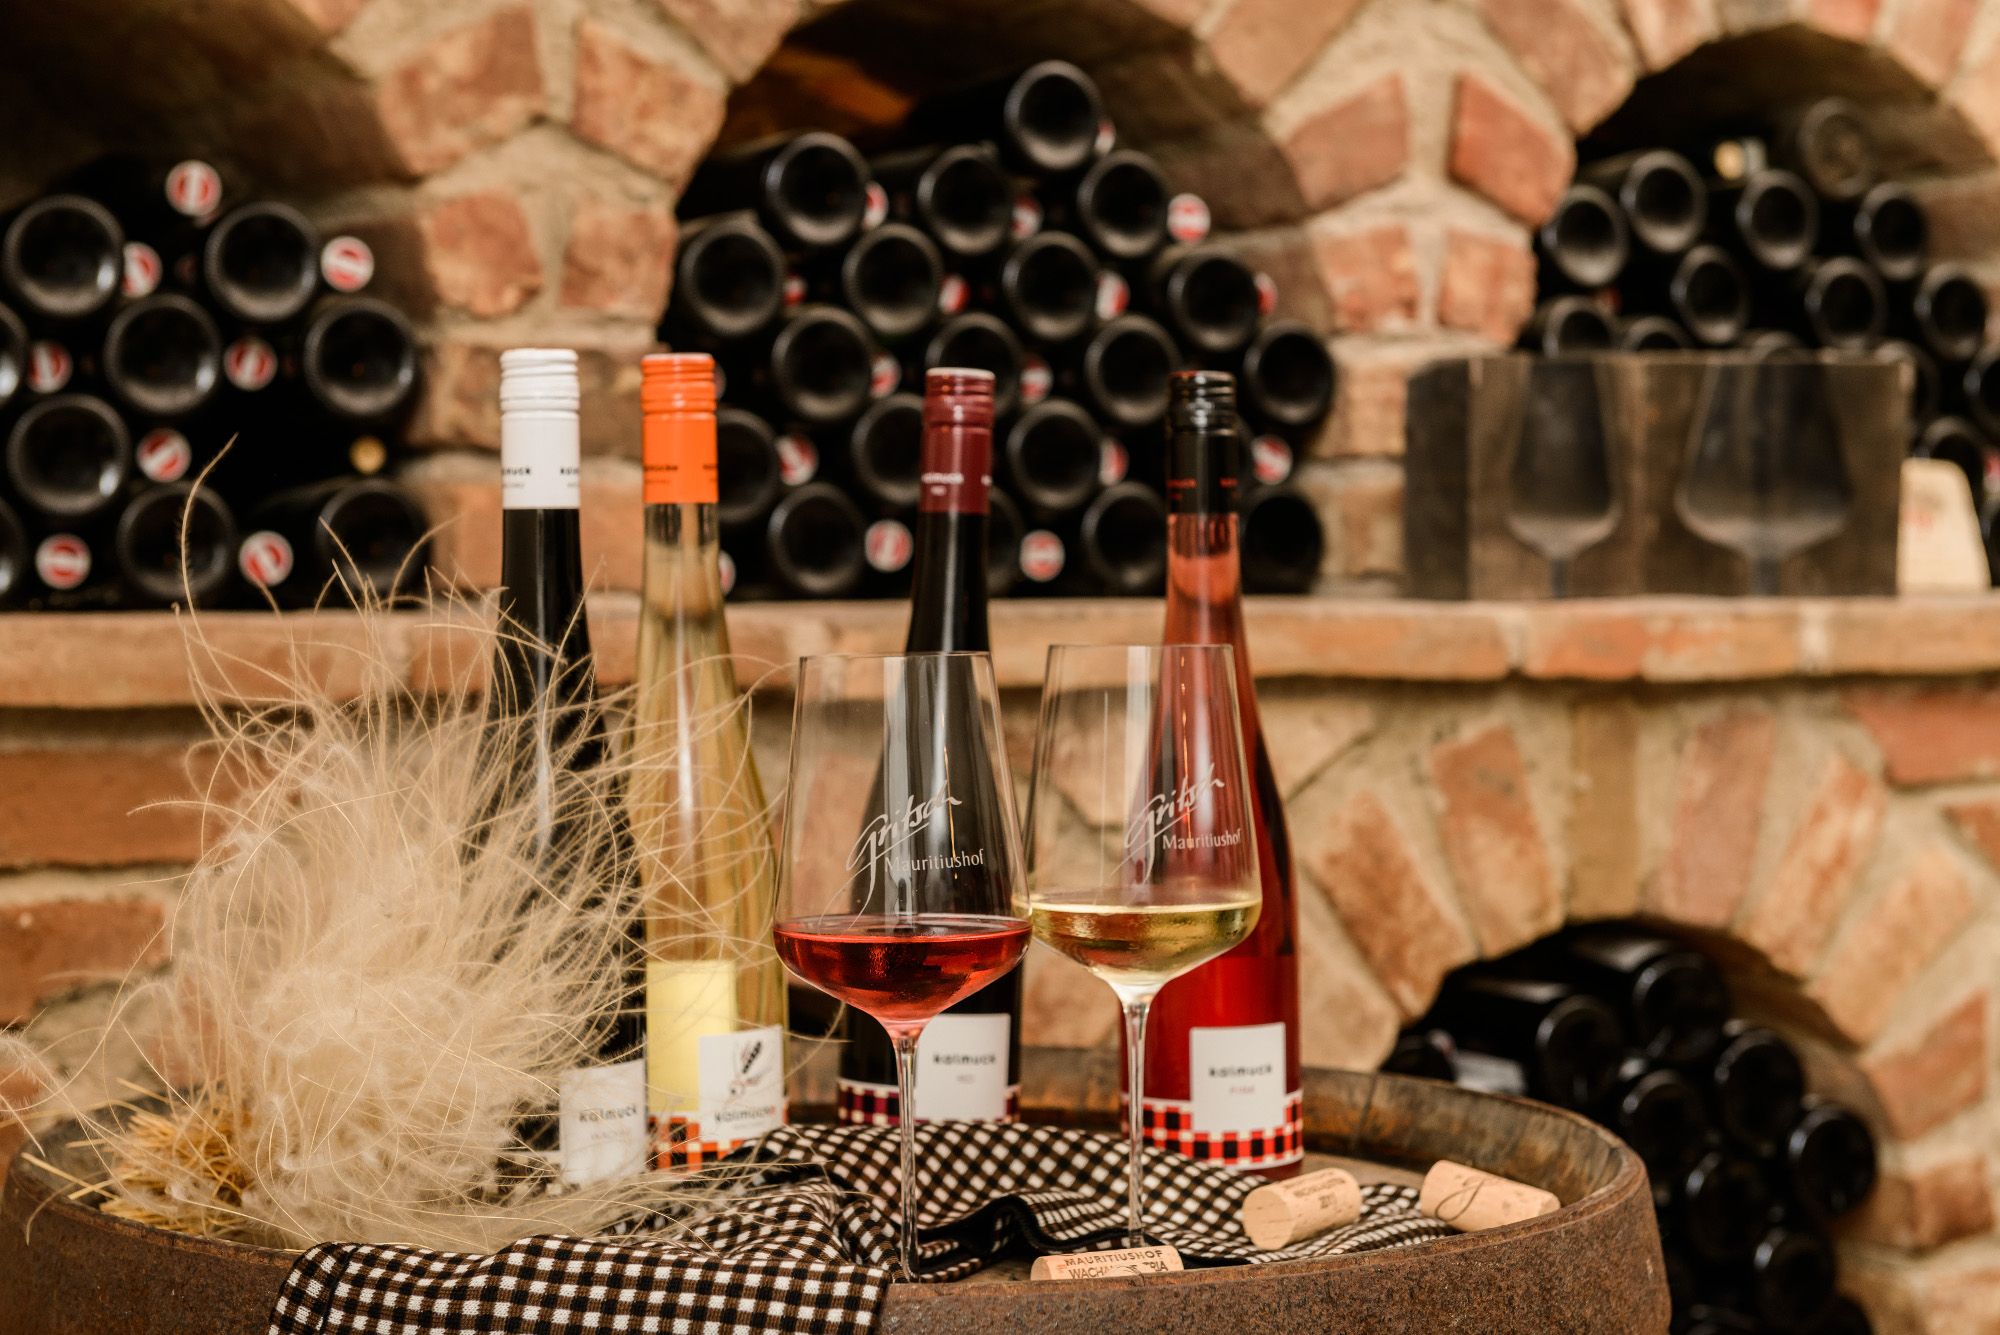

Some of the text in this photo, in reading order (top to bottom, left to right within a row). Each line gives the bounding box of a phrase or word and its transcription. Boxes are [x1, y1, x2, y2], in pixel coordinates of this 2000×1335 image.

[1162, 828, 1241, 850] Mauritiushof
[884, 848, 985, 873] Mauritiushof
[1064, 1249, 1164, 1267] MAURITIUSHOF
